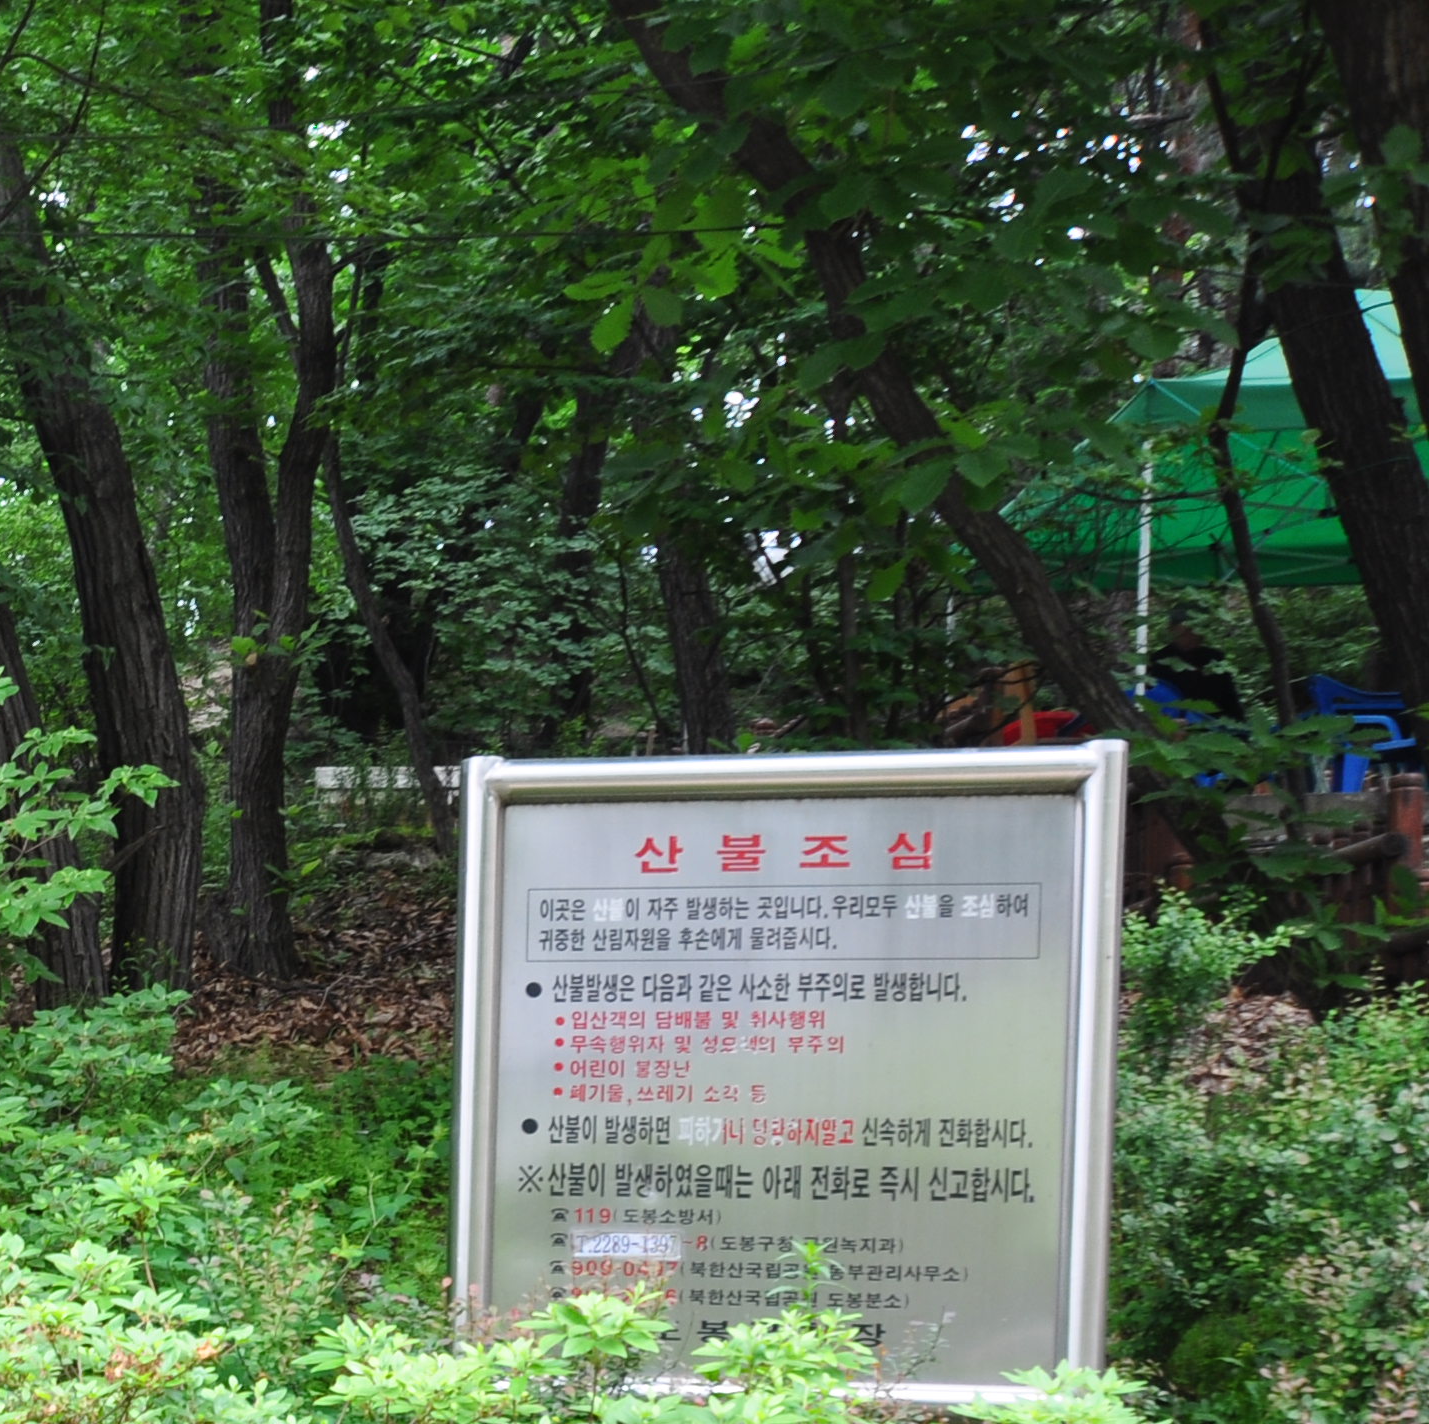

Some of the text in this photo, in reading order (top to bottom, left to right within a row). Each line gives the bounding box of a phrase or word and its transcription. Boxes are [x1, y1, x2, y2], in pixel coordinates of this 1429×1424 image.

[540, 892, 1029, 922] 이곳은 산불이 자주 발생하는 곳입니다. 우리모두 산불을 조심하여
[538, 926, 838, 952] 귀중한 산림자원을 후손에게 물려줍시다.
[552, 972, 967, 1003] 산불발생은 다음과 같은 사소한 부주의로 발생합니다.
[571, 1010, 826, 1030] 입산객의 담배불 및 취사행위
[570, 1035, 664, 1054] 무속행위자
[674, 1035, 692, 1054] 및
[788, 1035, 845, 1054] 부주의
[570, 1060, 691, 1079] 어린이 불장난
[703, 1084, 739, 1103] 소각
[749, 1084, 767, 1104] 등
[548, 1115, 597, 1145] 산불이
[605, 1115, 670, 1145] 발생하면
[678, 1116, 744, 1146] 피하거나
[862, 1117, 931, 1148] 신속하게
[939, 1117, 1033, 1149] 진화합시다.
[547, 1162, 1035, 1203] 산불이 발생하였을때는 아래 전화로 즉시 신고합시다.
[804, 1237, 904, 1254] 원녹지과)
[828, 1292, 910, 1309] 도봉분소)
